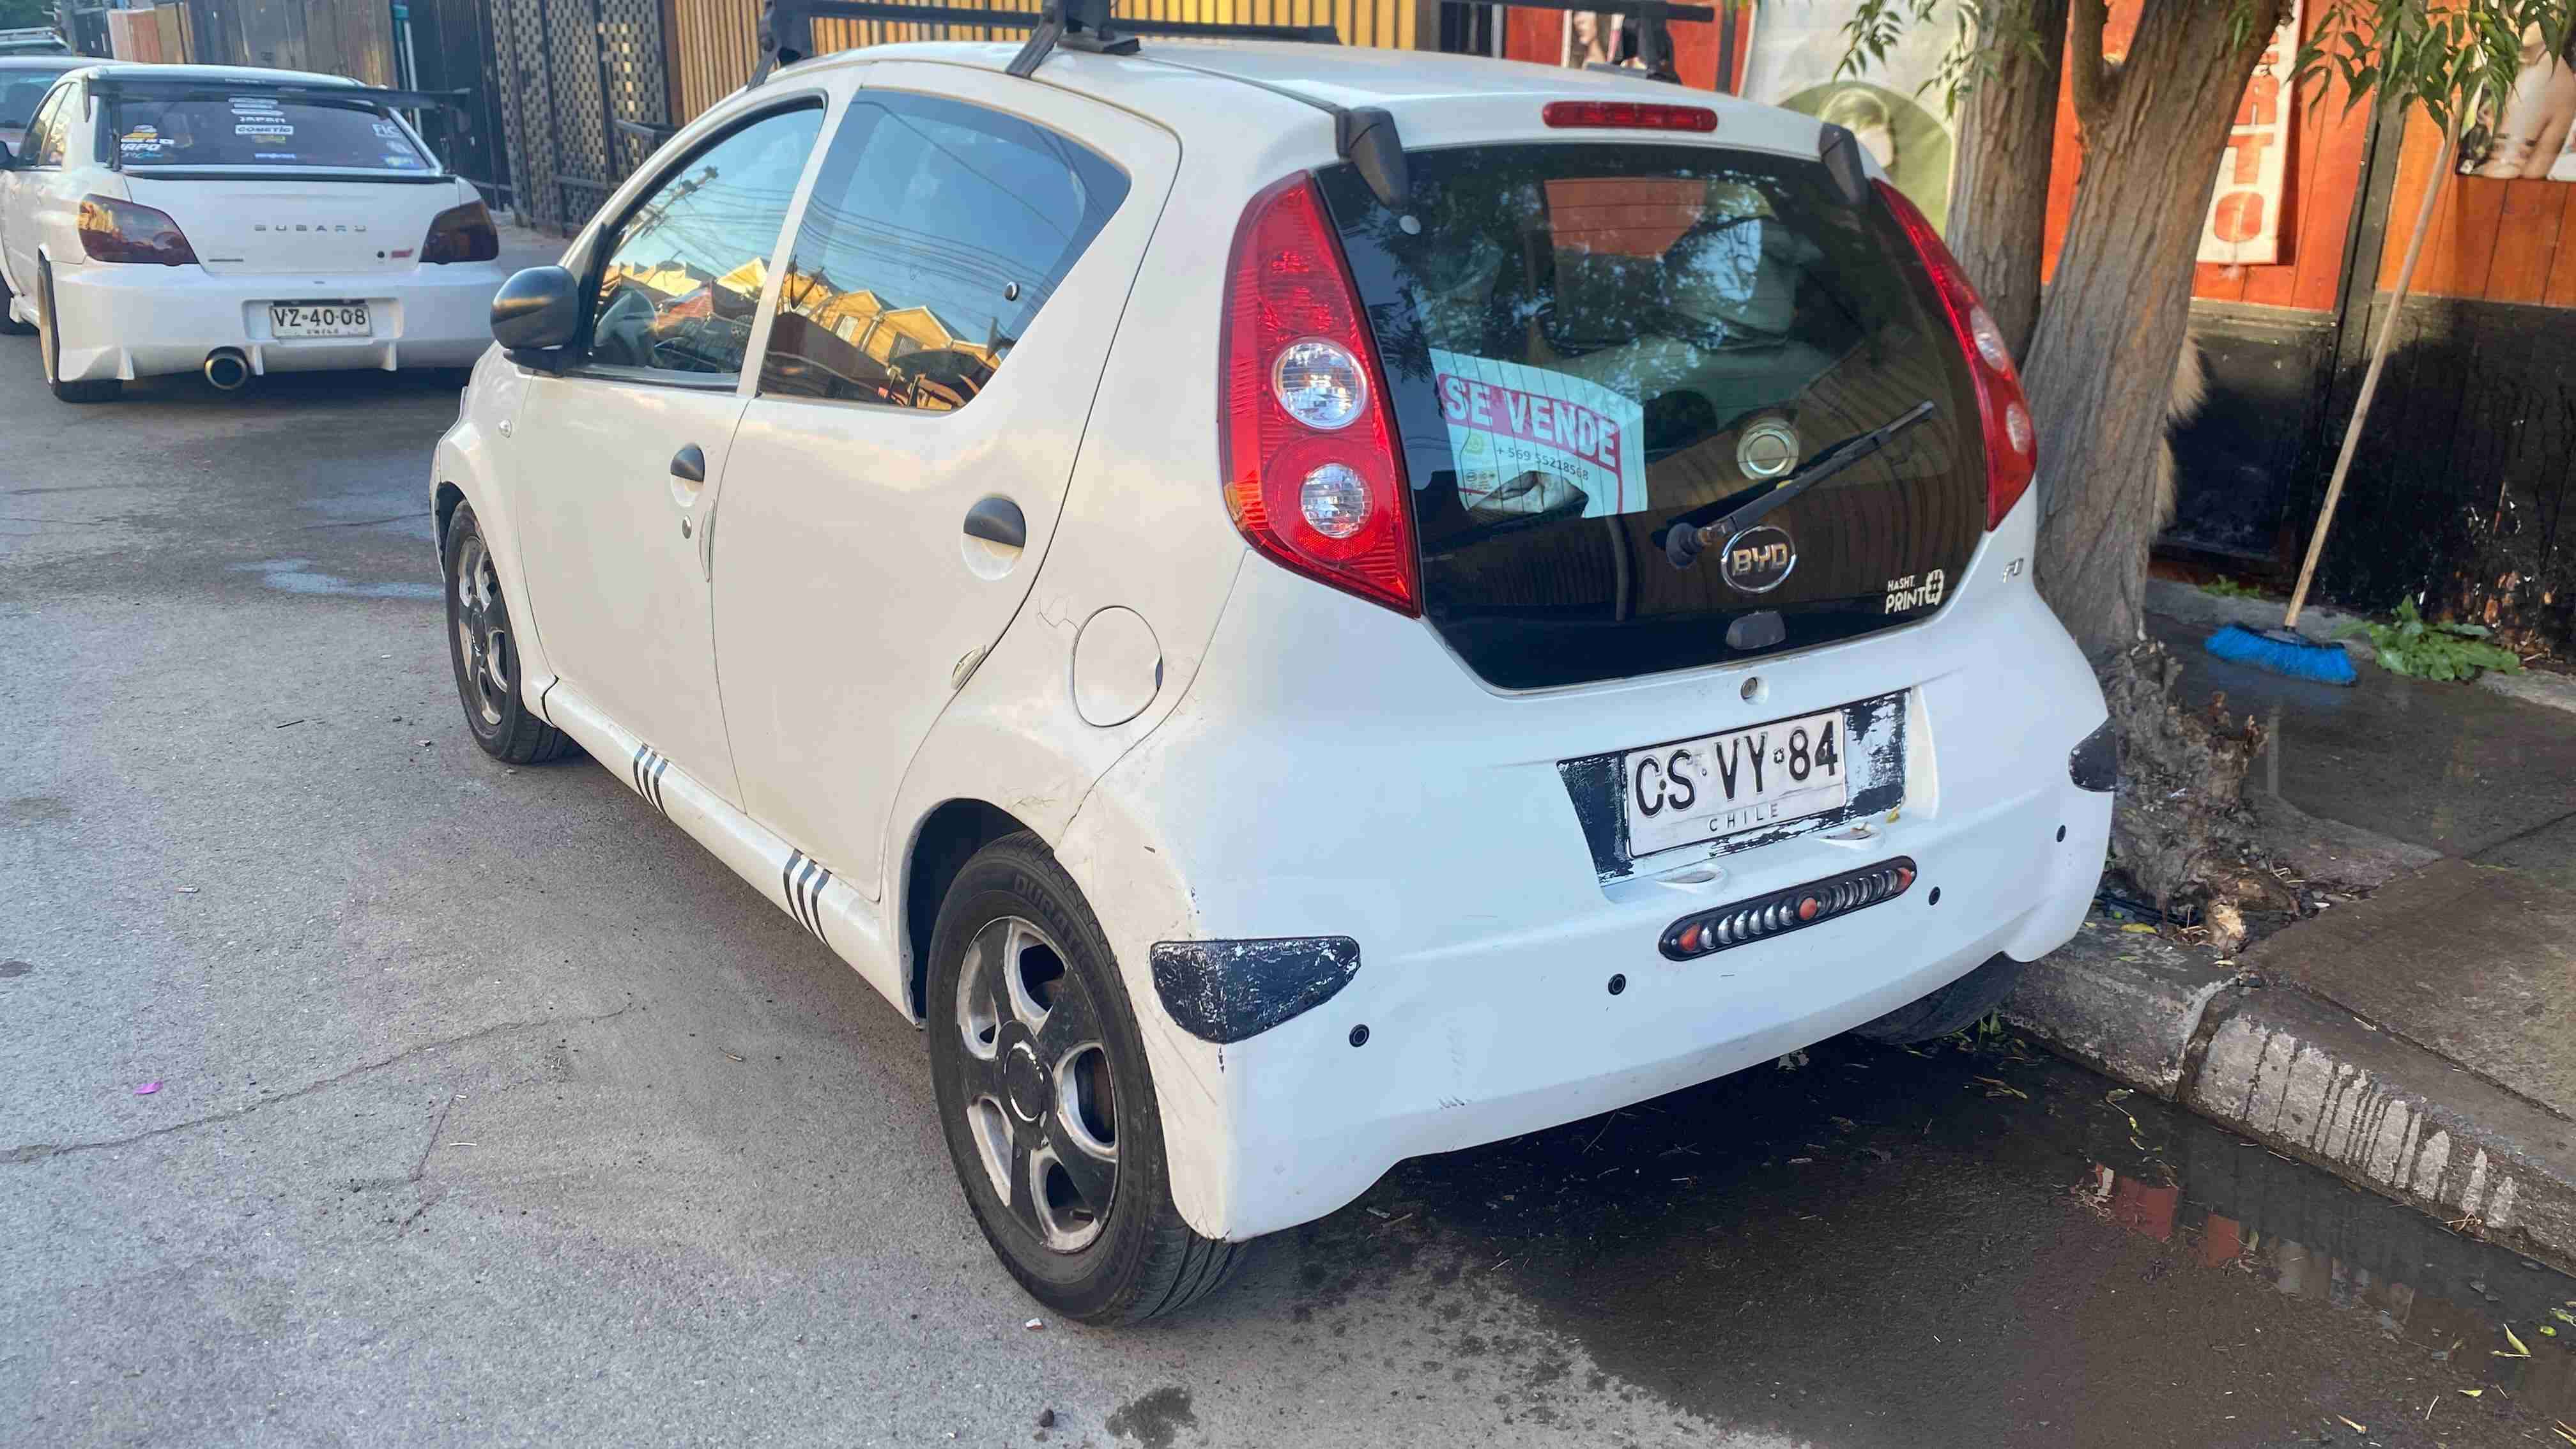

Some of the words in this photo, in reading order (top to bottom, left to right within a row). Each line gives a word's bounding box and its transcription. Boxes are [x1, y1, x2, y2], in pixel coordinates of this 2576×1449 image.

[1444, 378, 1492, 426] SE
[1503, 389, 1617, 468] VENDE
[1508, 448, 1531, 461] 569
[1535, 452, 1589, 480] 55218568
[1733, 543, 1788, 576] BYD
[1709, 803, 1779, 832] CHILE
